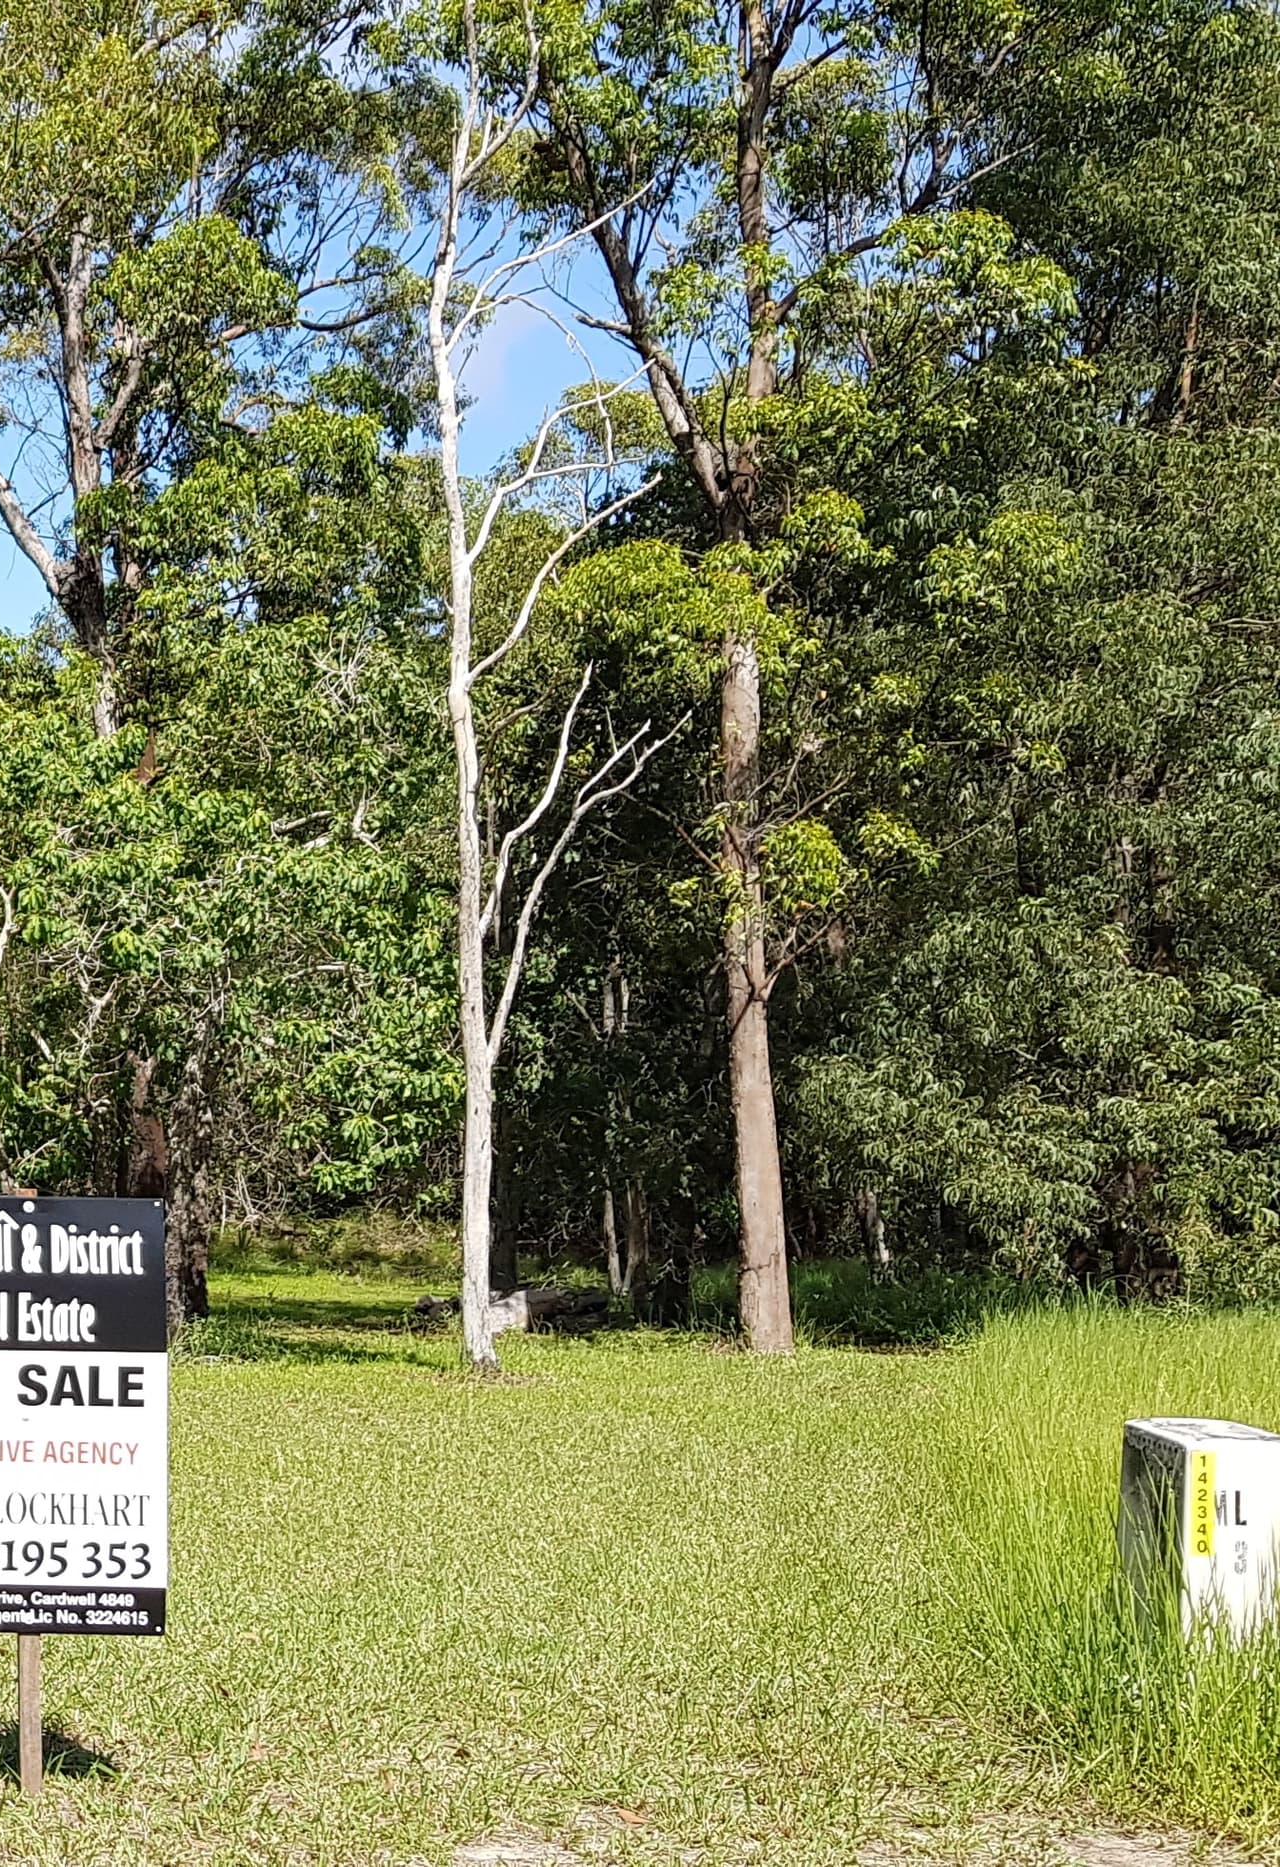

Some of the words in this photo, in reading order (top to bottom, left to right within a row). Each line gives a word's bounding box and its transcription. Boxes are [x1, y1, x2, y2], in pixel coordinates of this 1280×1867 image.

[21, 1223, 43, 1273] &
[50, 1224, 144, 1275] District
[17, 1292, 96, 1343] Estate
[17, 1364, 145, 1408] SALE
[43, 1441, 139, 1465] AGENCY
[1197, 1455, 1208, 1553] 142340
[1, 1540, 69, 1578] 195
[81, 1541, 152, 1580] 353
[30, 1591, 96, 1606] Cardwell
[98, 1593, 135, 1607] 4849
[55, 1609, 83, 1624] No.
[85, 1610, 149, 1626] 3224615
